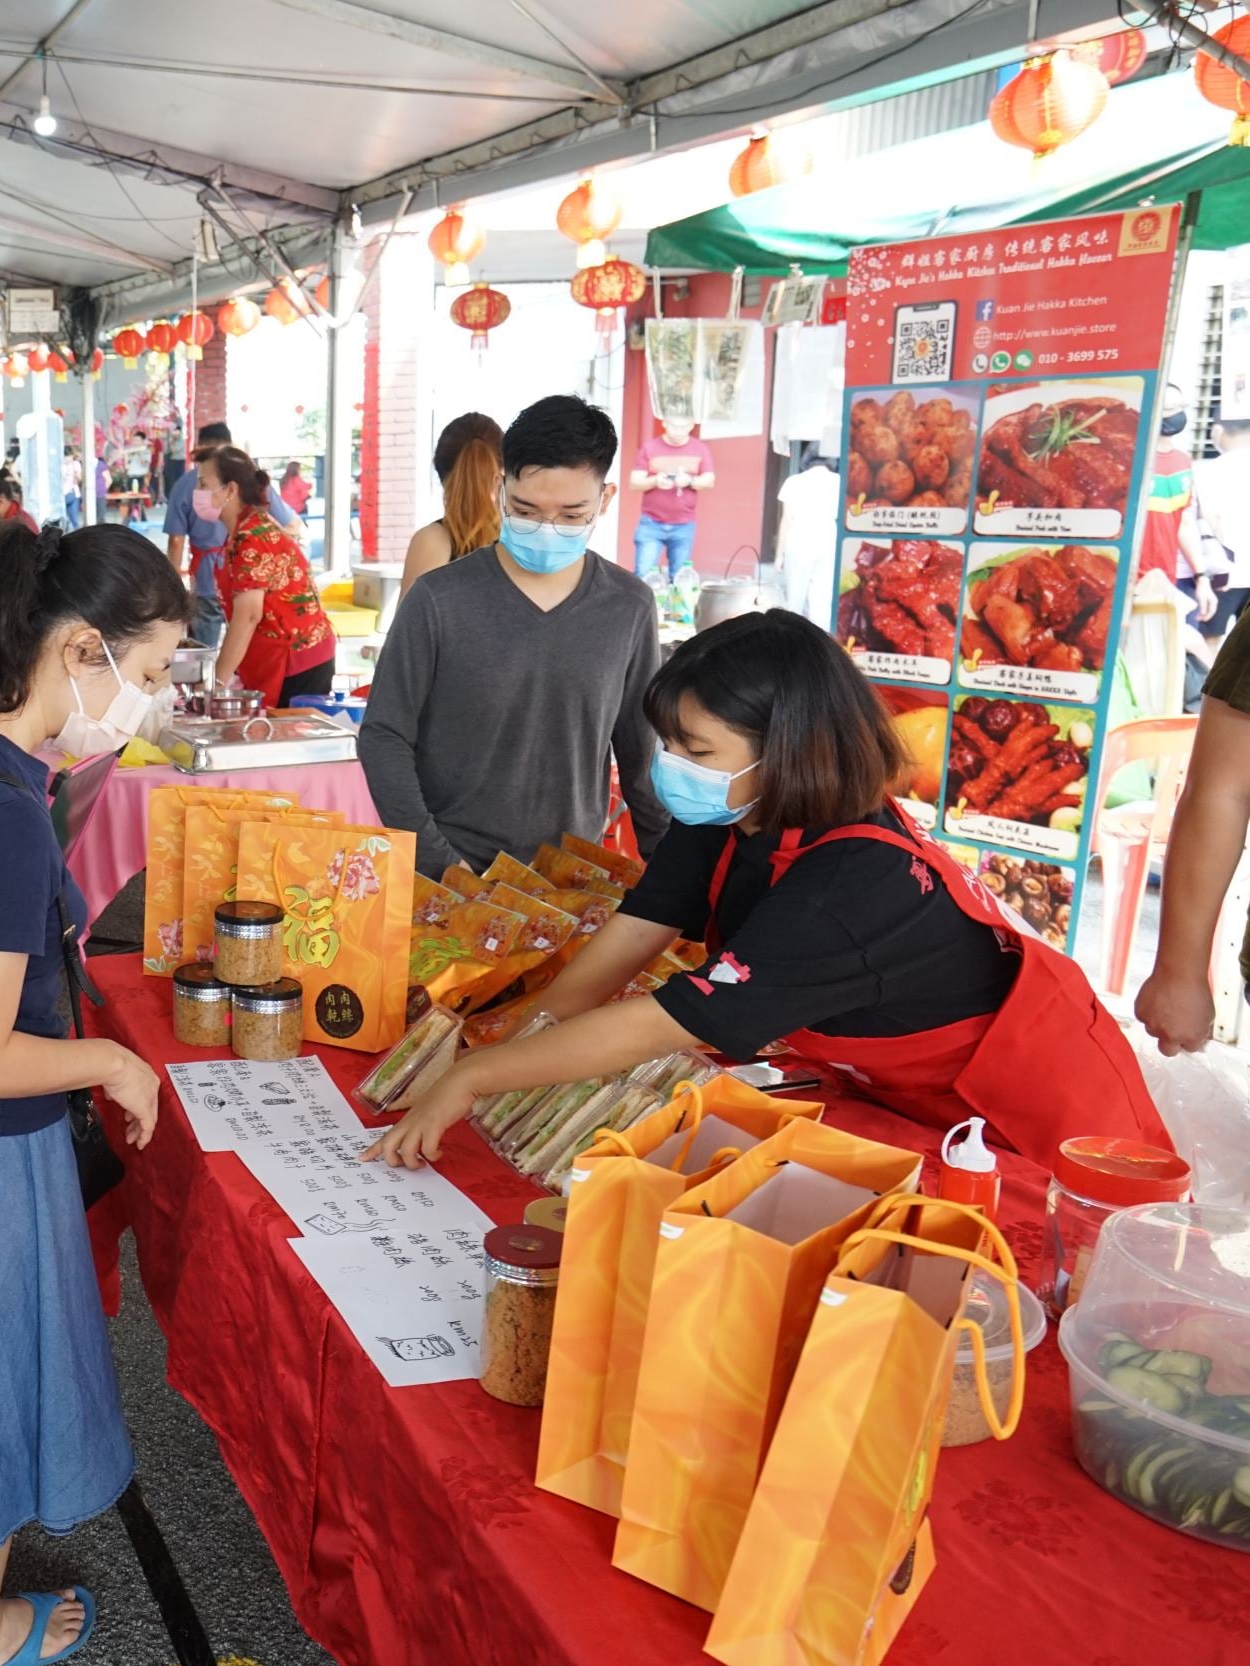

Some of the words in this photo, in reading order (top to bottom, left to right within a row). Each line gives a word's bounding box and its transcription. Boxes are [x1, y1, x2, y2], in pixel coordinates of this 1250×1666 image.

[999, 257, 1045, 273] Traditional
[996, 302, 1021, 314] Kuan
[1022, 300, 1036, 313] Jie
[1036, 297, 1066, 311] Hakka
[1068, 294, 1107, 308] Kitchen
[993, 322, 1117, 342] http://www.kuanjie.store
[1038, 351, 1058, 363] 010
[1066, 350, 1095, 362] 3699
[1096, 348, 1119, 360] 575
[283, 885, 340, 969] 福
[322, 1202, 347, 1219] RM70
[381, 1195, 406, 1211] RM50
